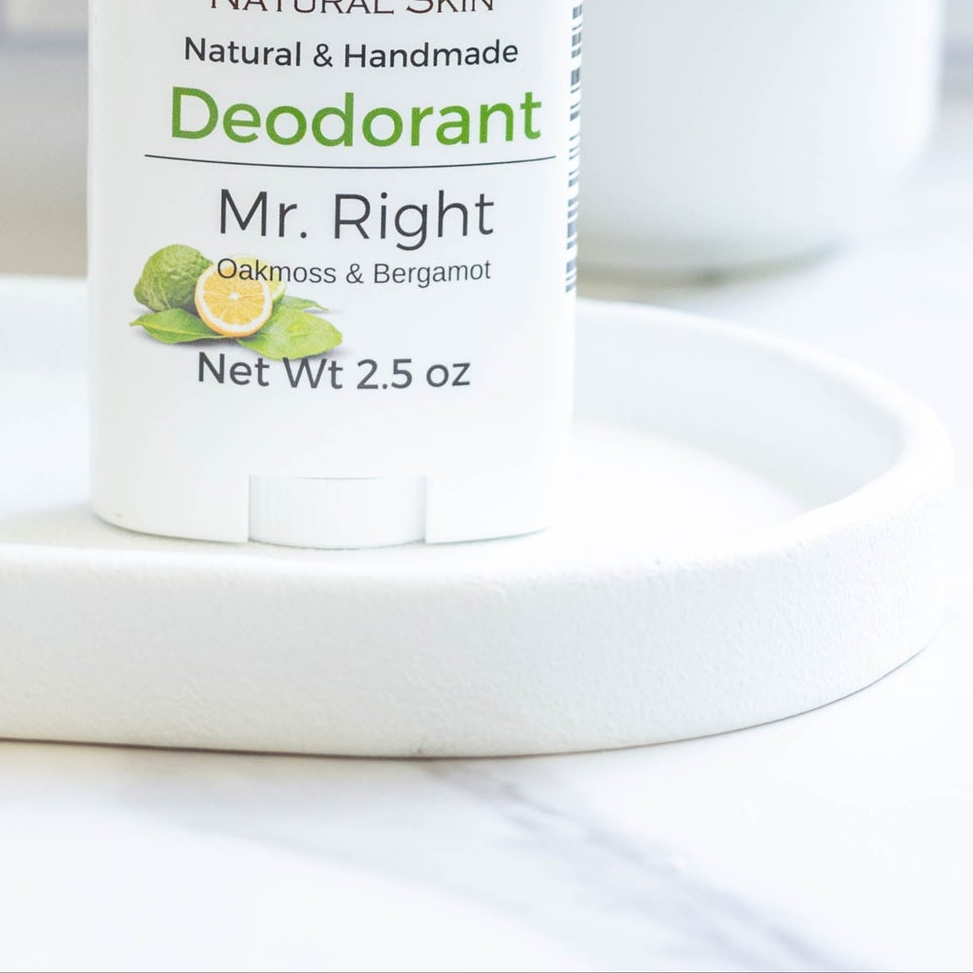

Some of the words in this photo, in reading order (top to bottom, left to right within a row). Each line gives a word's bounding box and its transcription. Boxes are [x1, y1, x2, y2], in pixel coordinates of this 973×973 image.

[184, 37, 301, 66] Natural
[313, 44, 333, 67] &
[344, 40, 518, 68] Handmade
[171, 87, 542, 147] Deodorant
[219, 188, 307, 238] Mr.
[334, 189, 495, 251] Right
[216, 258, 337, 284] Oakmoss
[346, 263, 364, 284] &
[374, 260, 491, 287] Bergamot
[198, 352, 269, 387] Net
[282, 358, 342, 389] Wt
[356, 358, 412, 390] 2.5
[426, 362, 471, 388] oz
